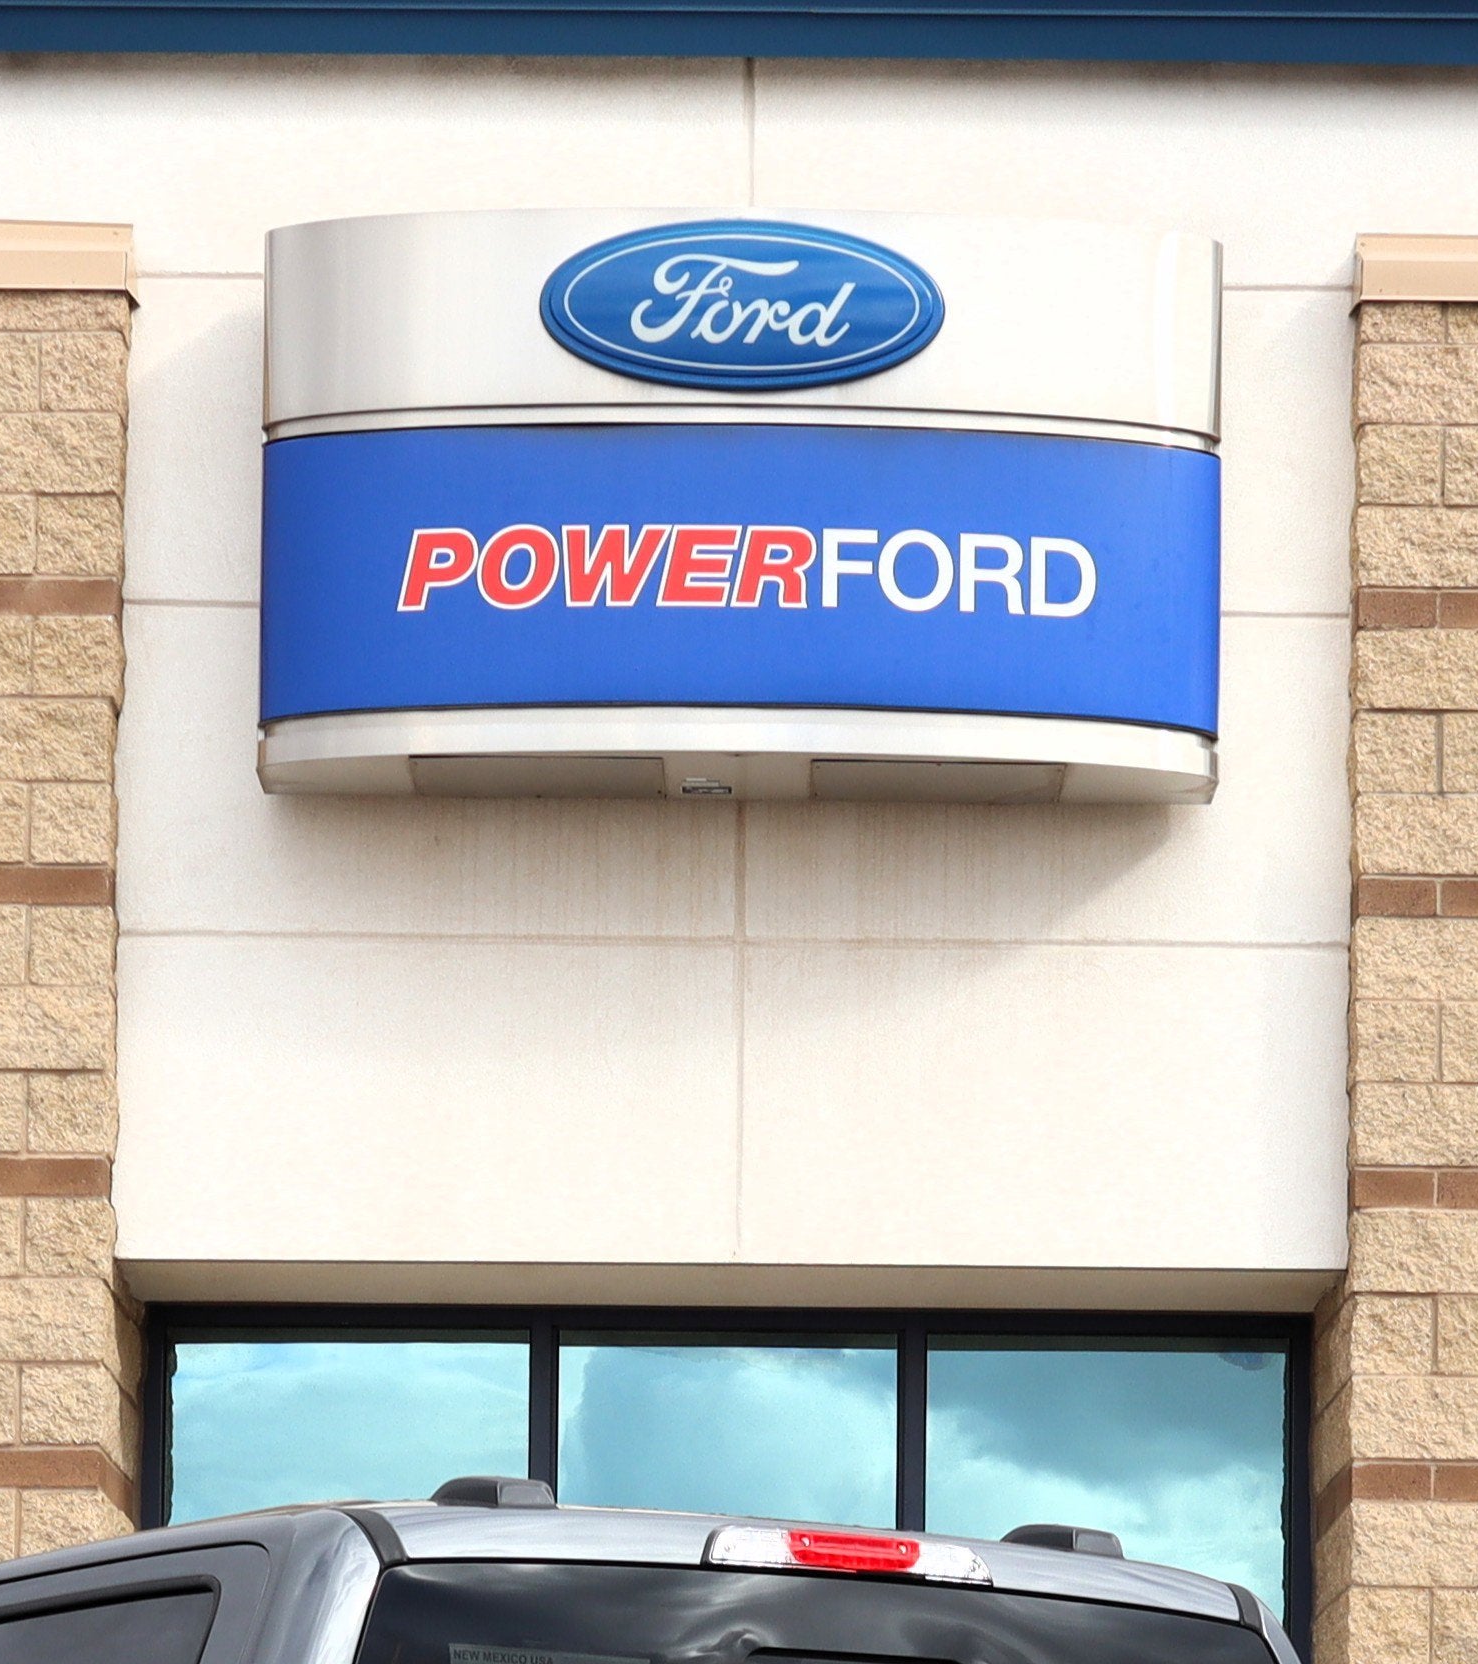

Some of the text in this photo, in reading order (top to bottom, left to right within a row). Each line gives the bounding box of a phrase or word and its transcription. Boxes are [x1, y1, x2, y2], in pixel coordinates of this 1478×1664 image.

[629, 253, 858, 349] Ford
[396, 522, 1098, 618] POWERFORD
[453, 1649, 479, 1661] NEW
[482, 1652, 527, 1664] MEXICO
